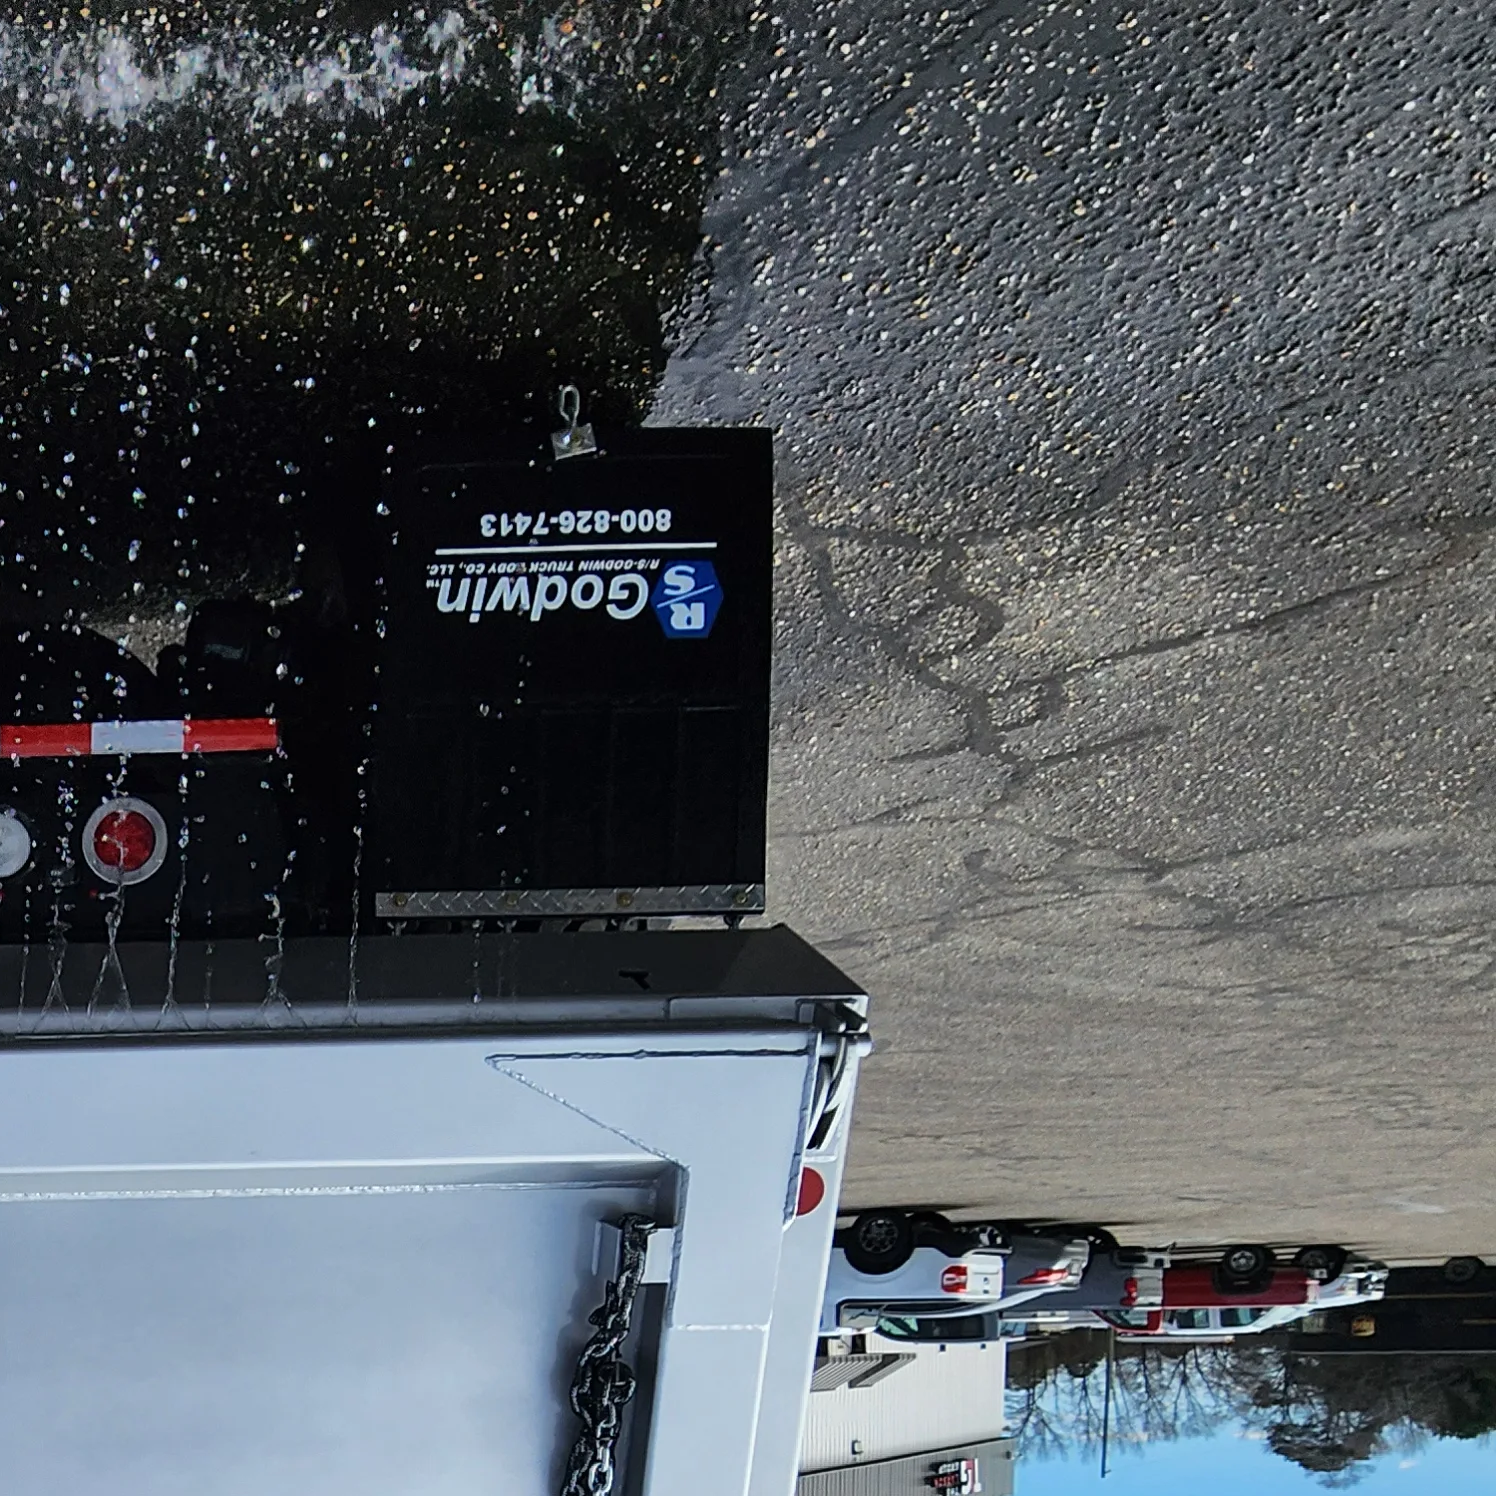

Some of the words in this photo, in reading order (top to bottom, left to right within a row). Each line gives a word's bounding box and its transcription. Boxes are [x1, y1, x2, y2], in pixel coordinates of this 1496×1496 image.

[480, 508, 672, 537] 800-826-7413
[488, 561, 526, 574] ODY
[529, 560, 574, 573] TRUCK
[436, 573, 650, 624] Godwin
